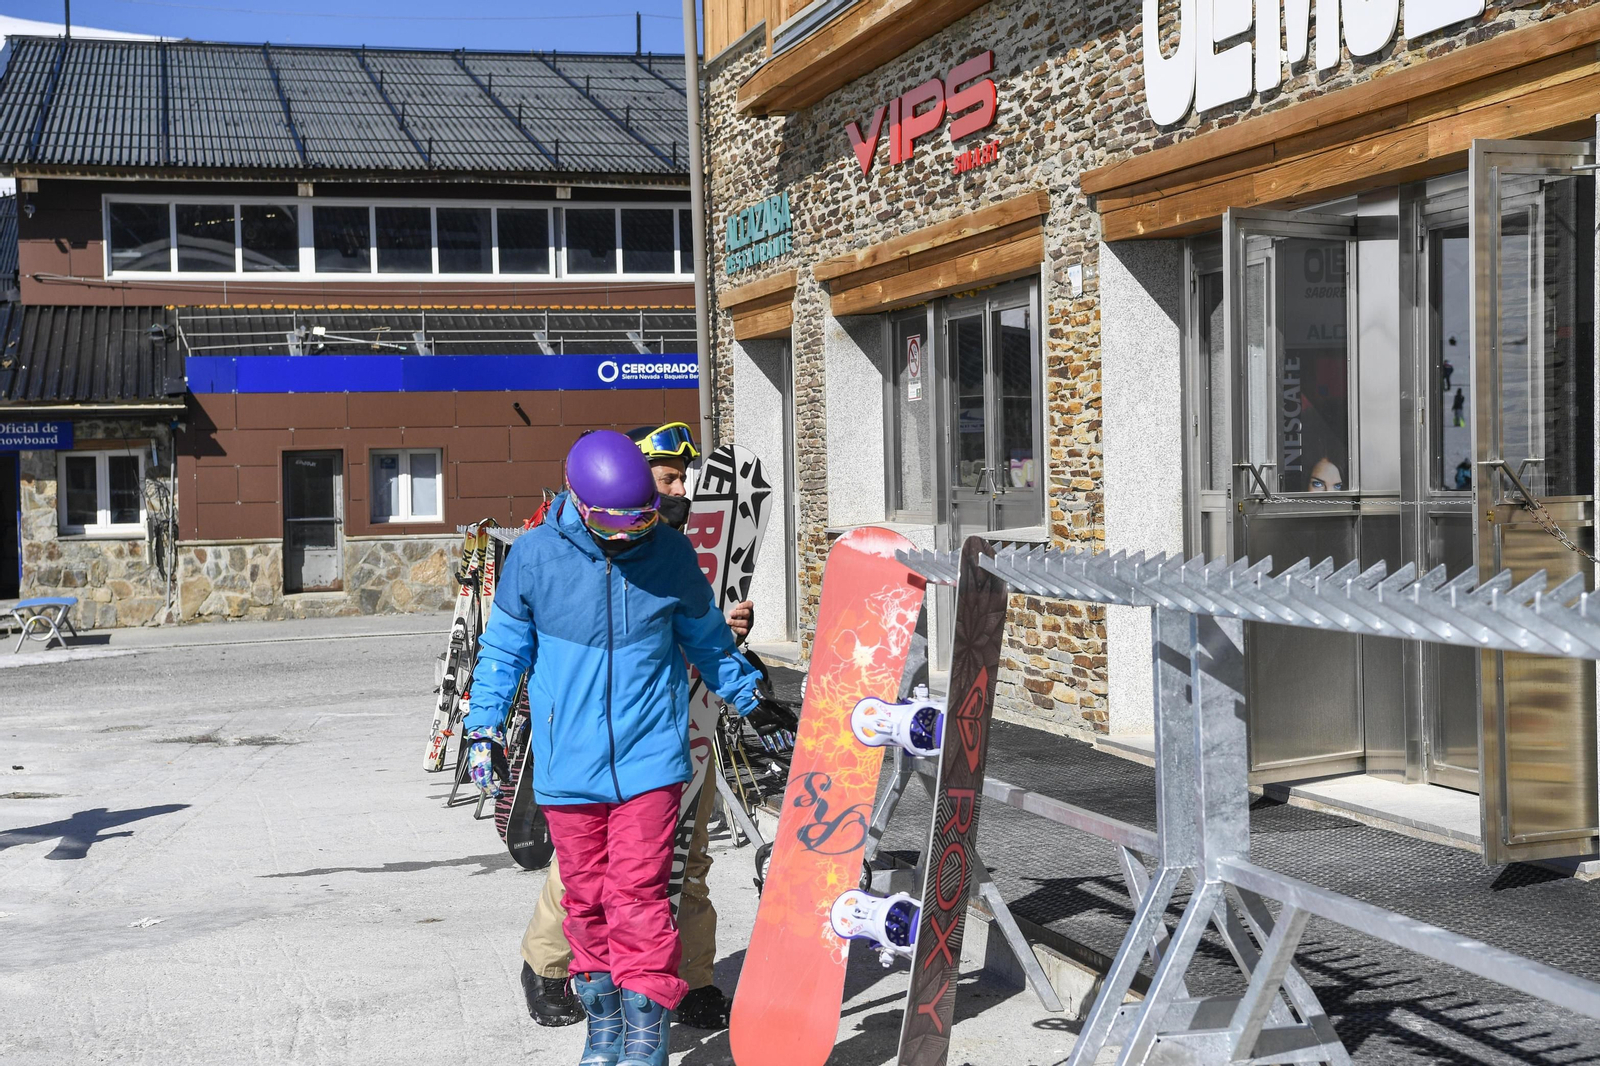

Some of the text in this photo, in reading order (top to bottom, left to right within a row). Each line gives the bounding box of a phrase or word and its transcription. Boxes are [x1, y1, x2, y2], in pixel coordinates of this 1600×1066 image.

[845, 50, 997, 177] VIPS
[952, 140, 999, 175] SMART
[725, 191, 791, 253] ALCAZABA
[725, 231, 793, 276] RESTAURANTE
[42, 423, 58, 433] de
[917, 788, 976, 1035] ROXY
